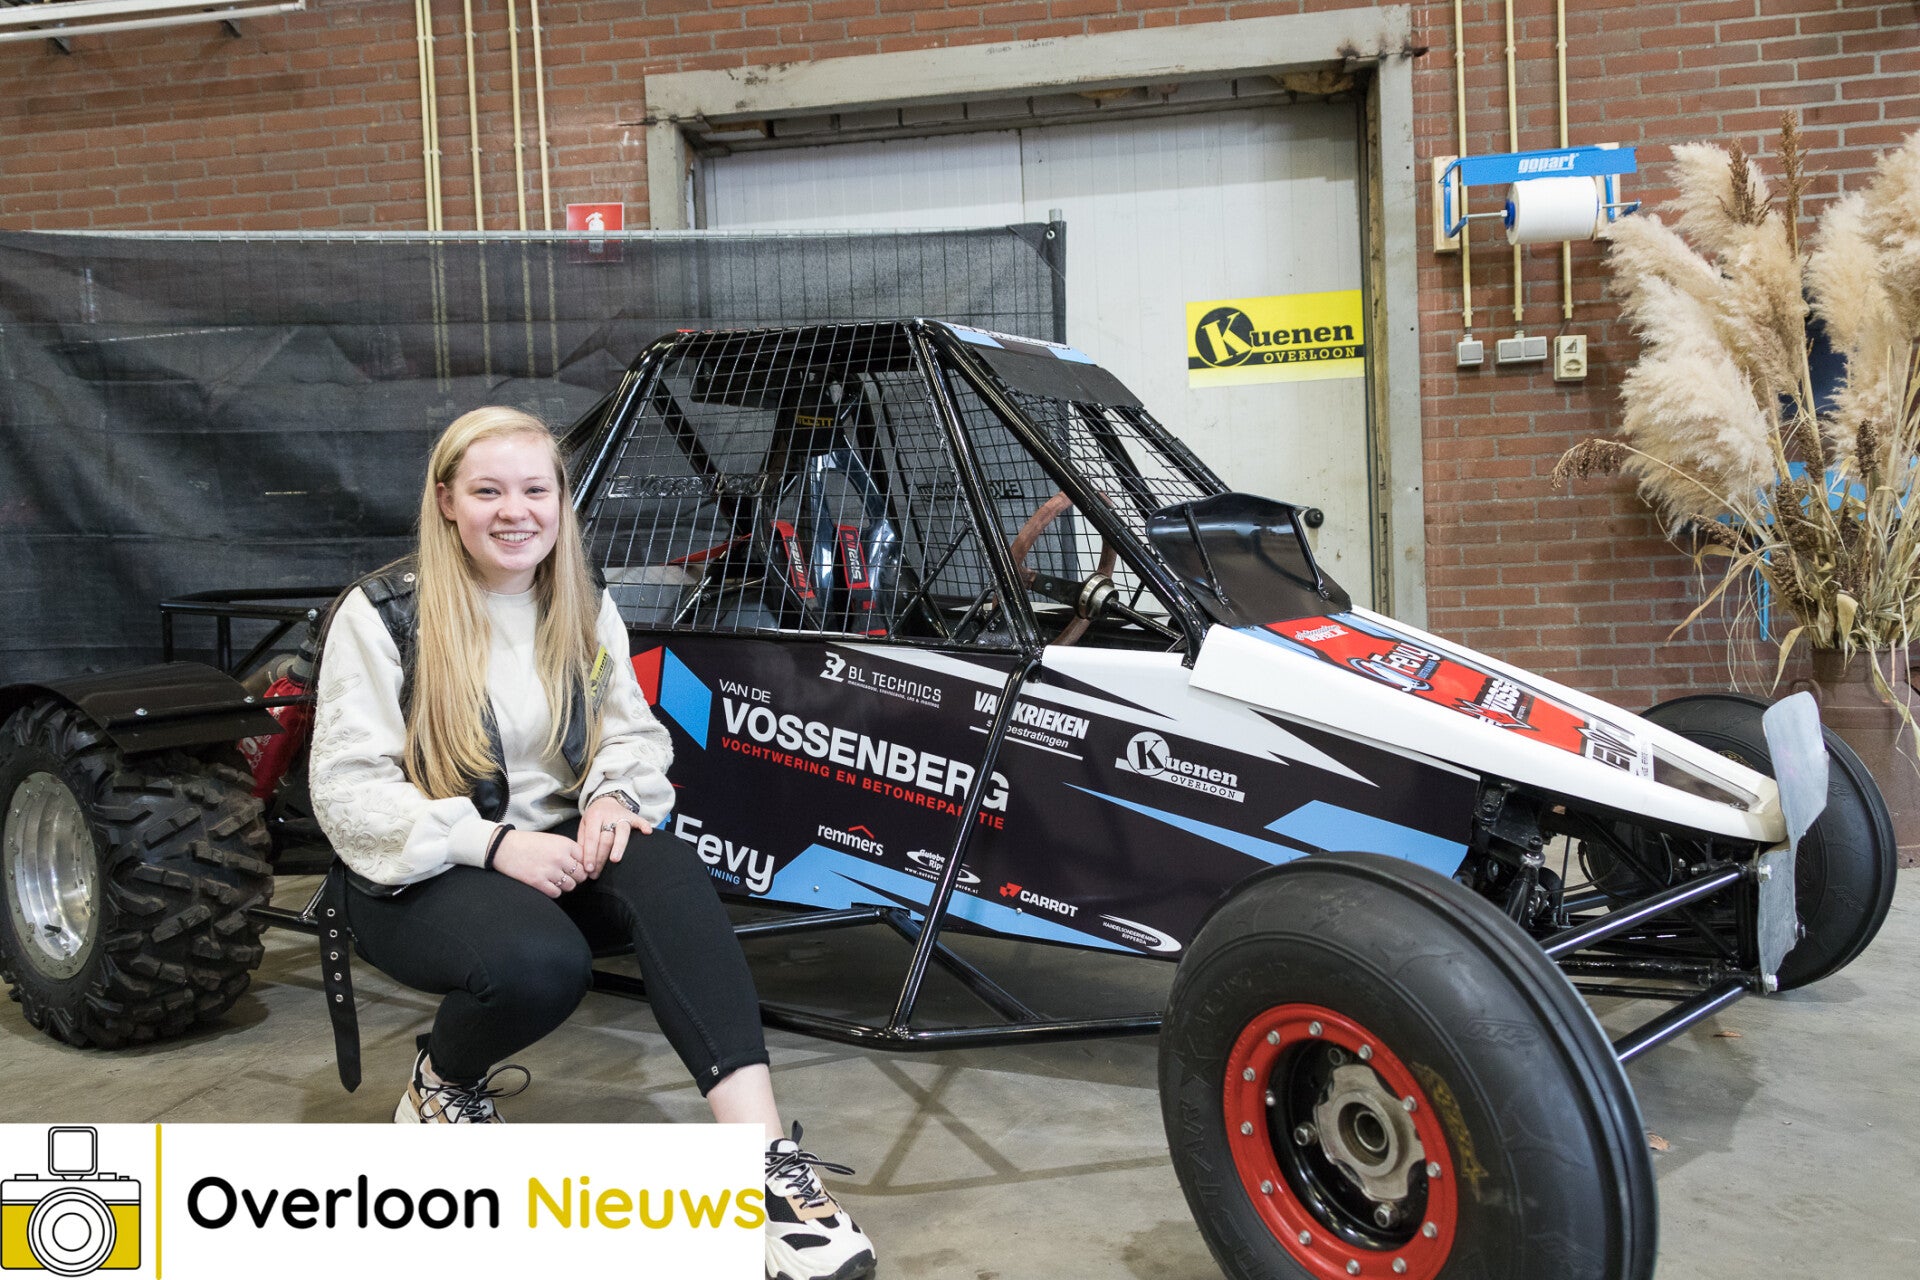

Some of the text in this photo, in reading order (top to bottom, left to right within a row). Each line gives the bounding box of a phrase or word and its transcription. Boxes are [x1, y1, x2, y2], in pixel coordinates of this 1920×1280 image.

[1201, 311, 1354, 364] Kuenen
[1263, 347, 1356, 364] OVERLOON
[848, 665, 866, 682] BL
[872, 671, 942, 702] TECHNICS
[719, 679, 771, 704] VAN DE
[973, 690, 1090, 740] VA KRIEKEN
[722, 697, 1010, 812] VOSSENBERG
[1134, 739, 1239, 787] Kuenen
[721, 736, 1005, 830] VOCHTWERING EN BETONREPATIE
[1170, 775, 1237, 799] OVERLOON
[817, 824, 884, 857] remmers
[1019, 890, 1079, 917] CARROT
